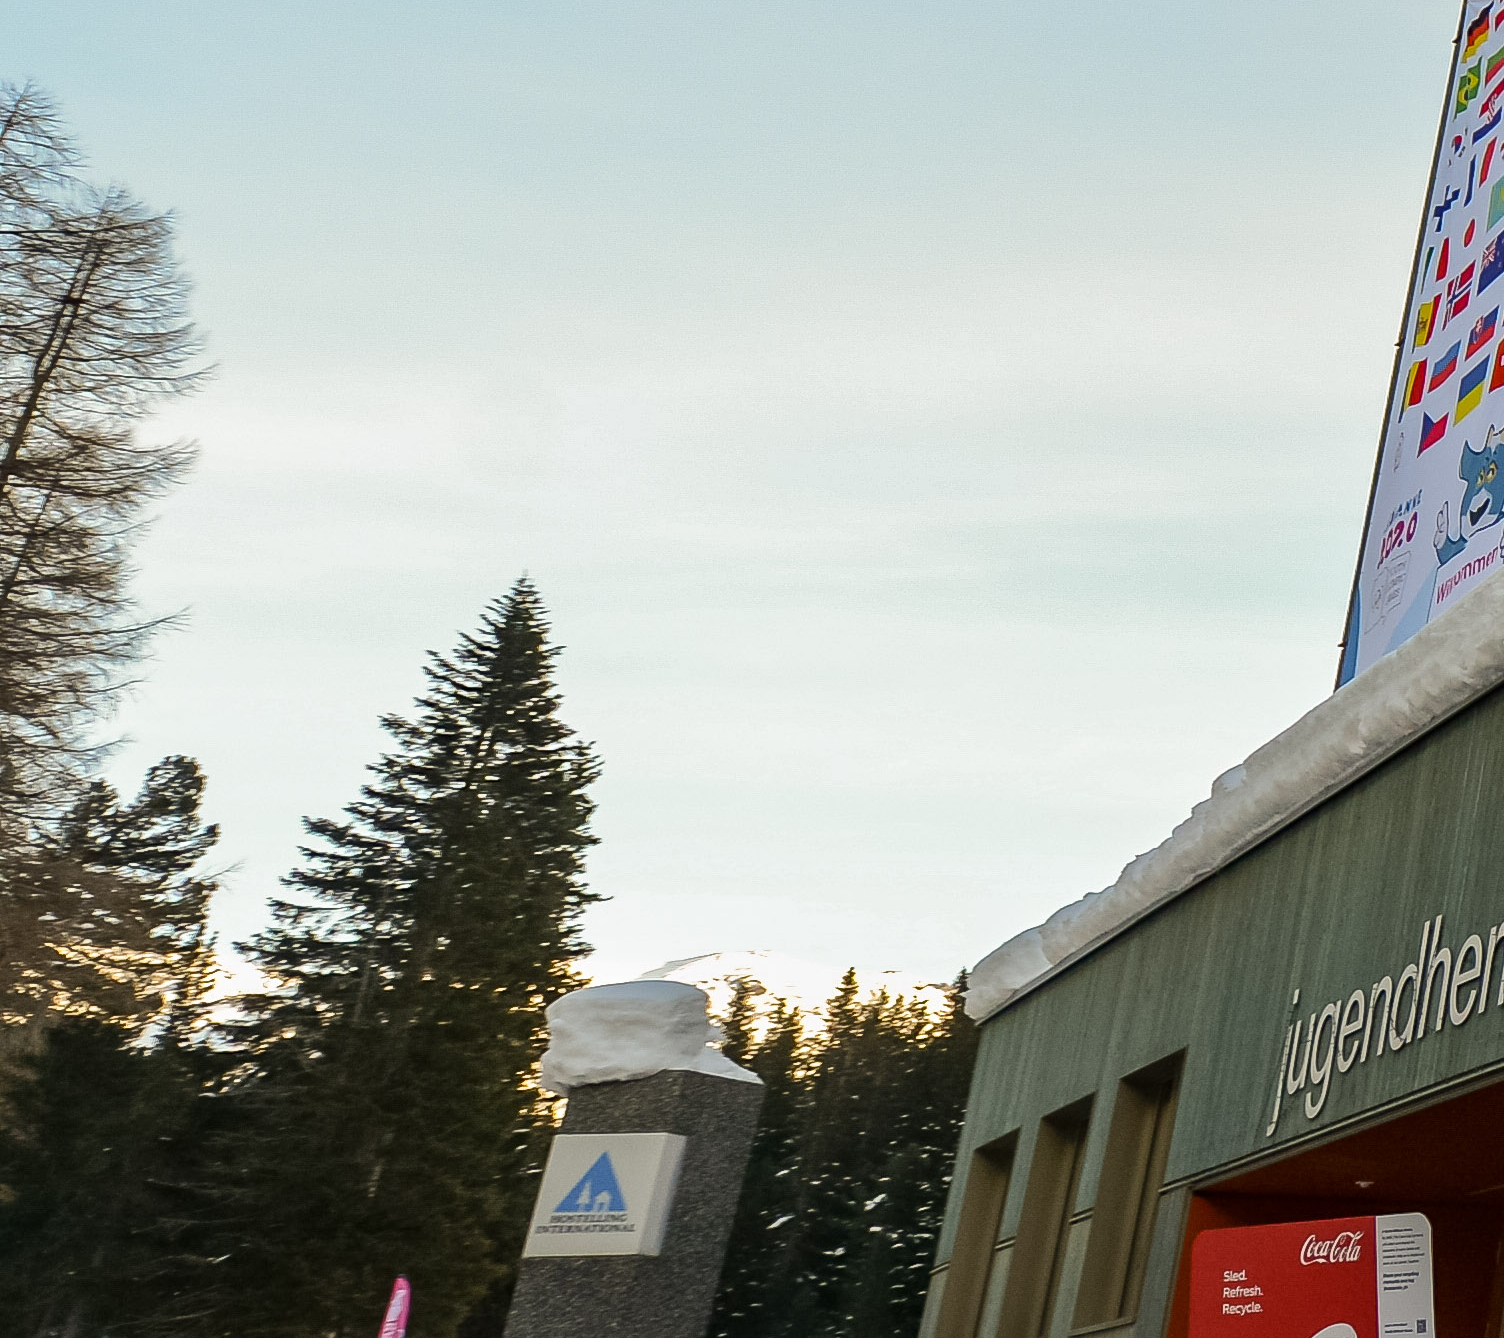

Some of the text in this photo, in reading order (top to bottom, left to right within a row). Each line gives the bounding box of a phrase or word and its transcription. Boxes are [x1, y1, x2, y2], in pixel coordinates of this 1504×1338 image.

[550, 1213, 628, 1224] HOSTELLING
[535, 1223, 636, 1235] INTERNATIONAL
[1223, 1269, 1248, 1282] Sled.
[1223, 1285, 1264, 1299] Refresh.
[1222, 1301, 1264, 1317] Recycle.
